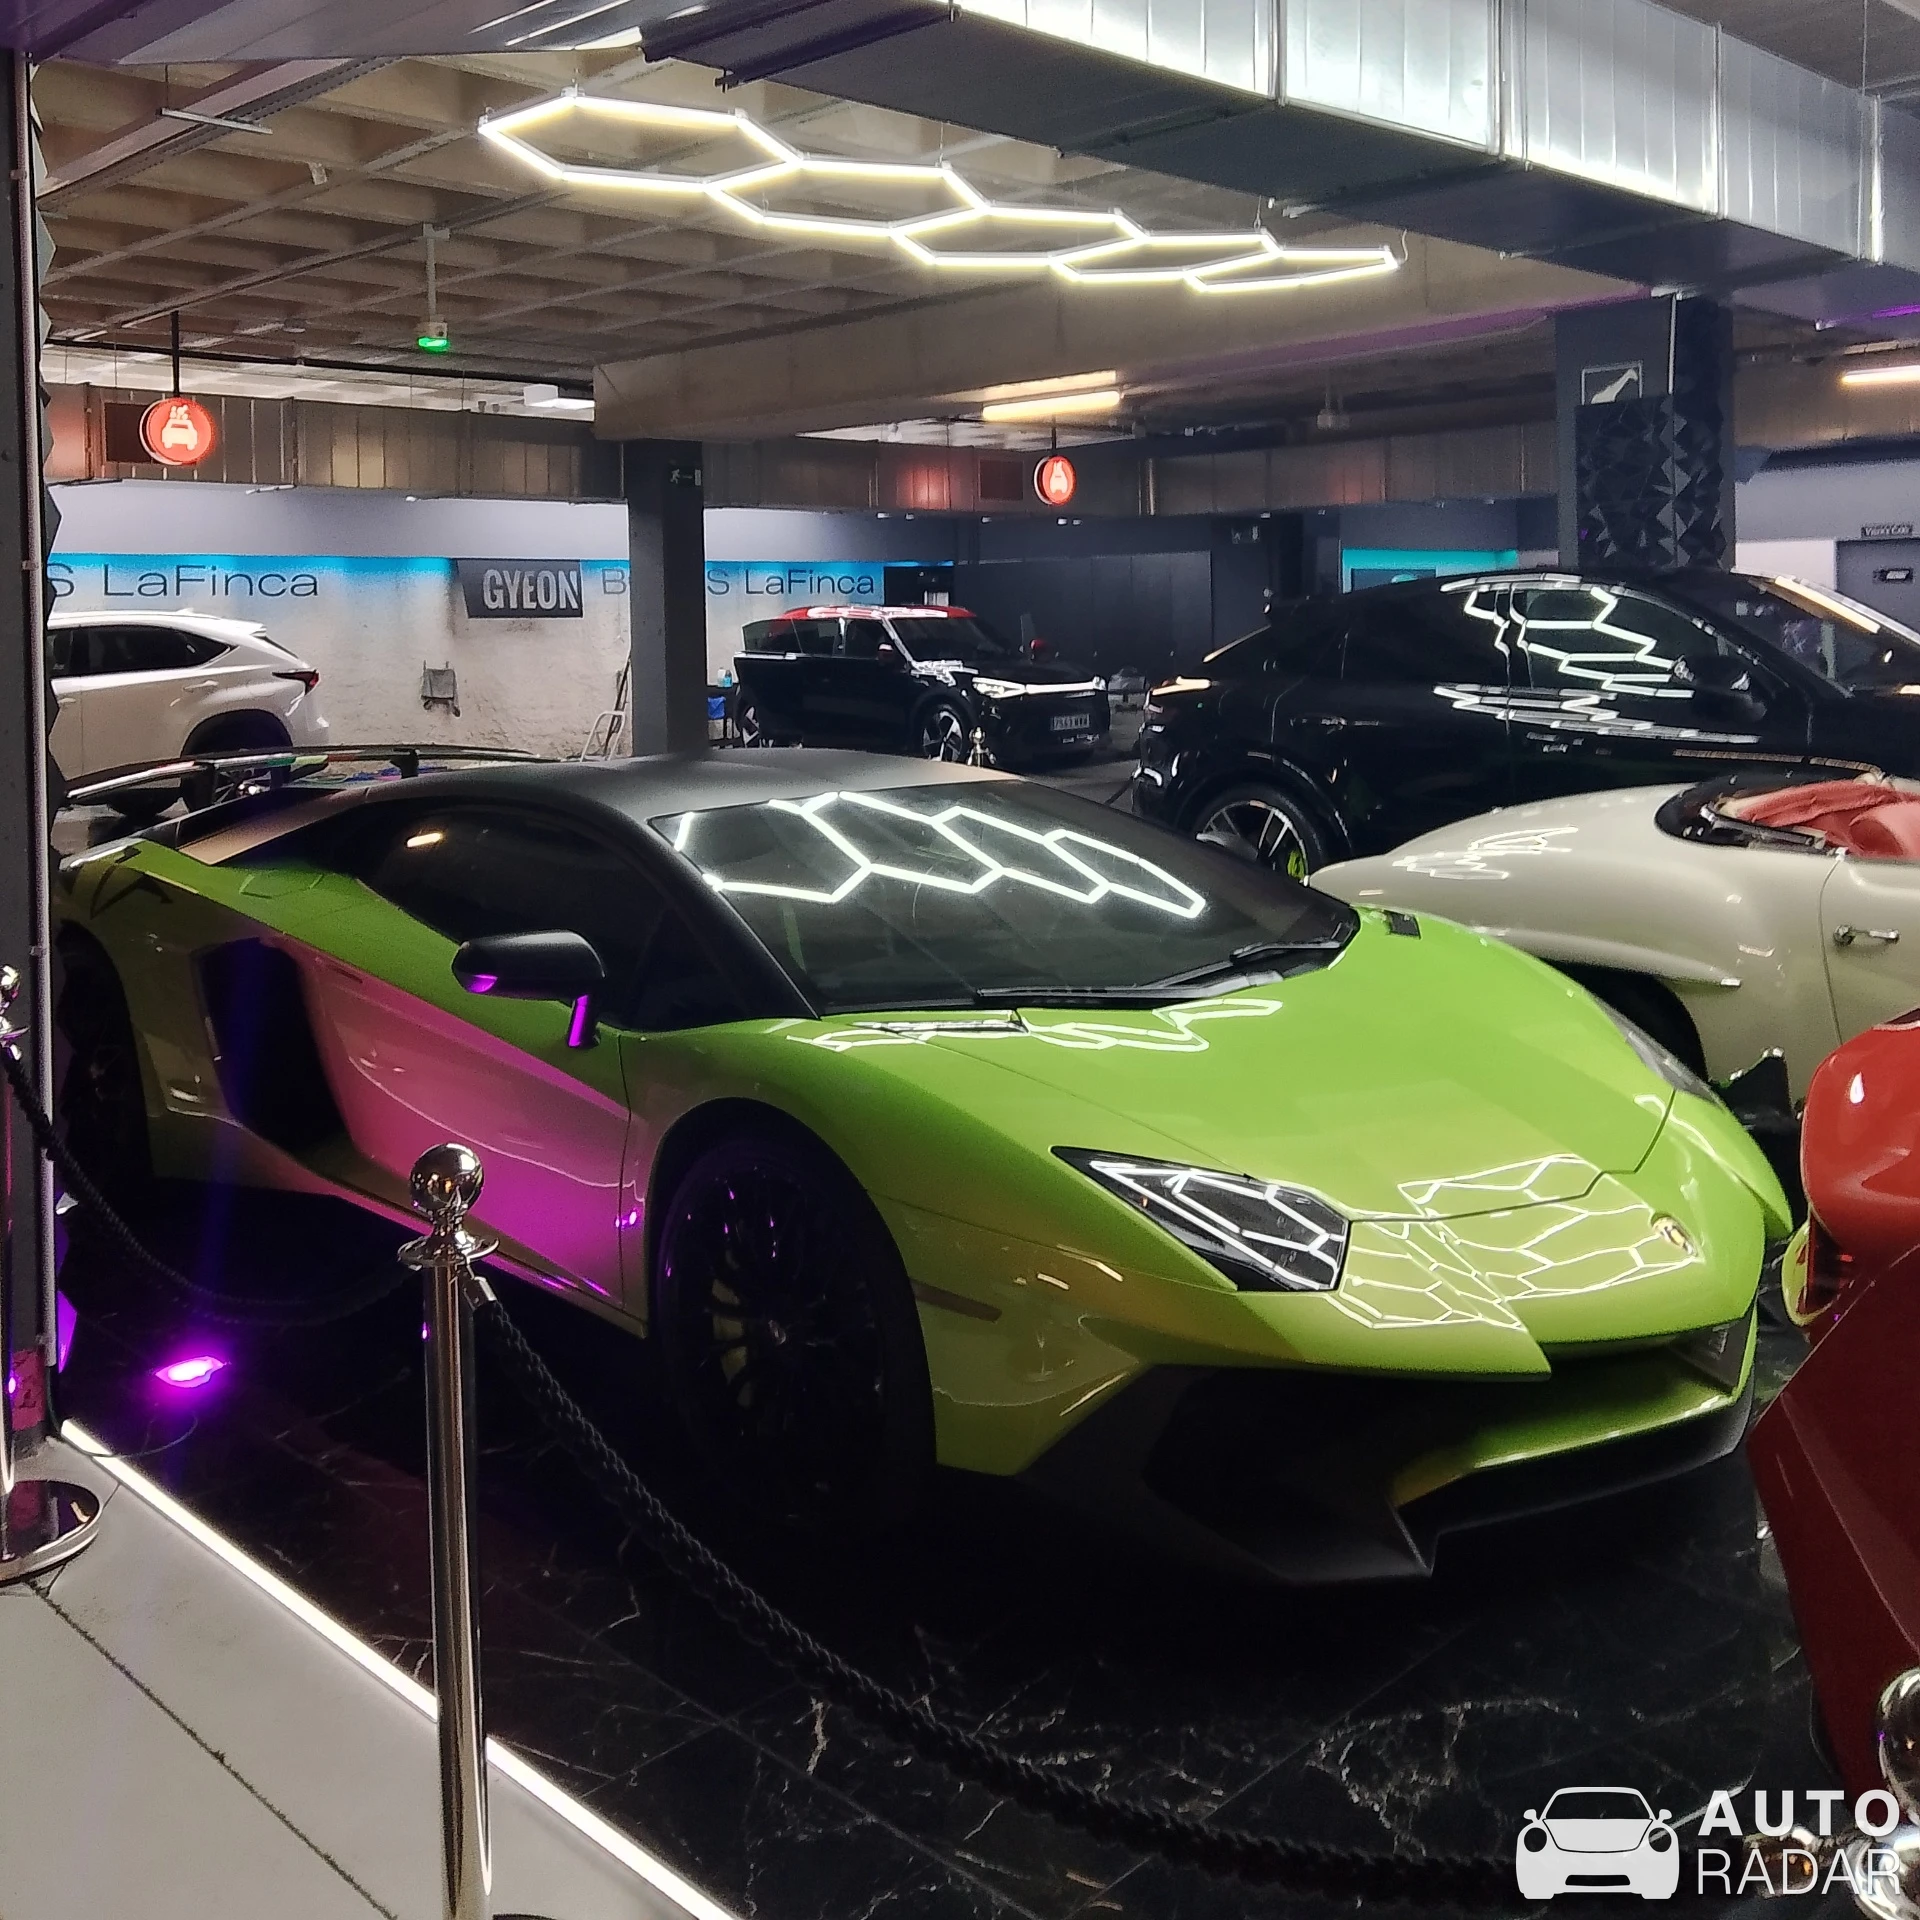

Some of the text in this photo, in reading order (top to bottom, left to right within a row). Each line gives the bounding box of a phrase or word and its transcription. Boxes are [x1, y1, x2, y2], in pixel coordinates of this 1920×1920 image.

[103, 563, 319, 597] LaFinca
[482, 568, 580, 610] GYEON
[744, 567, 874, 596] LaFinca
